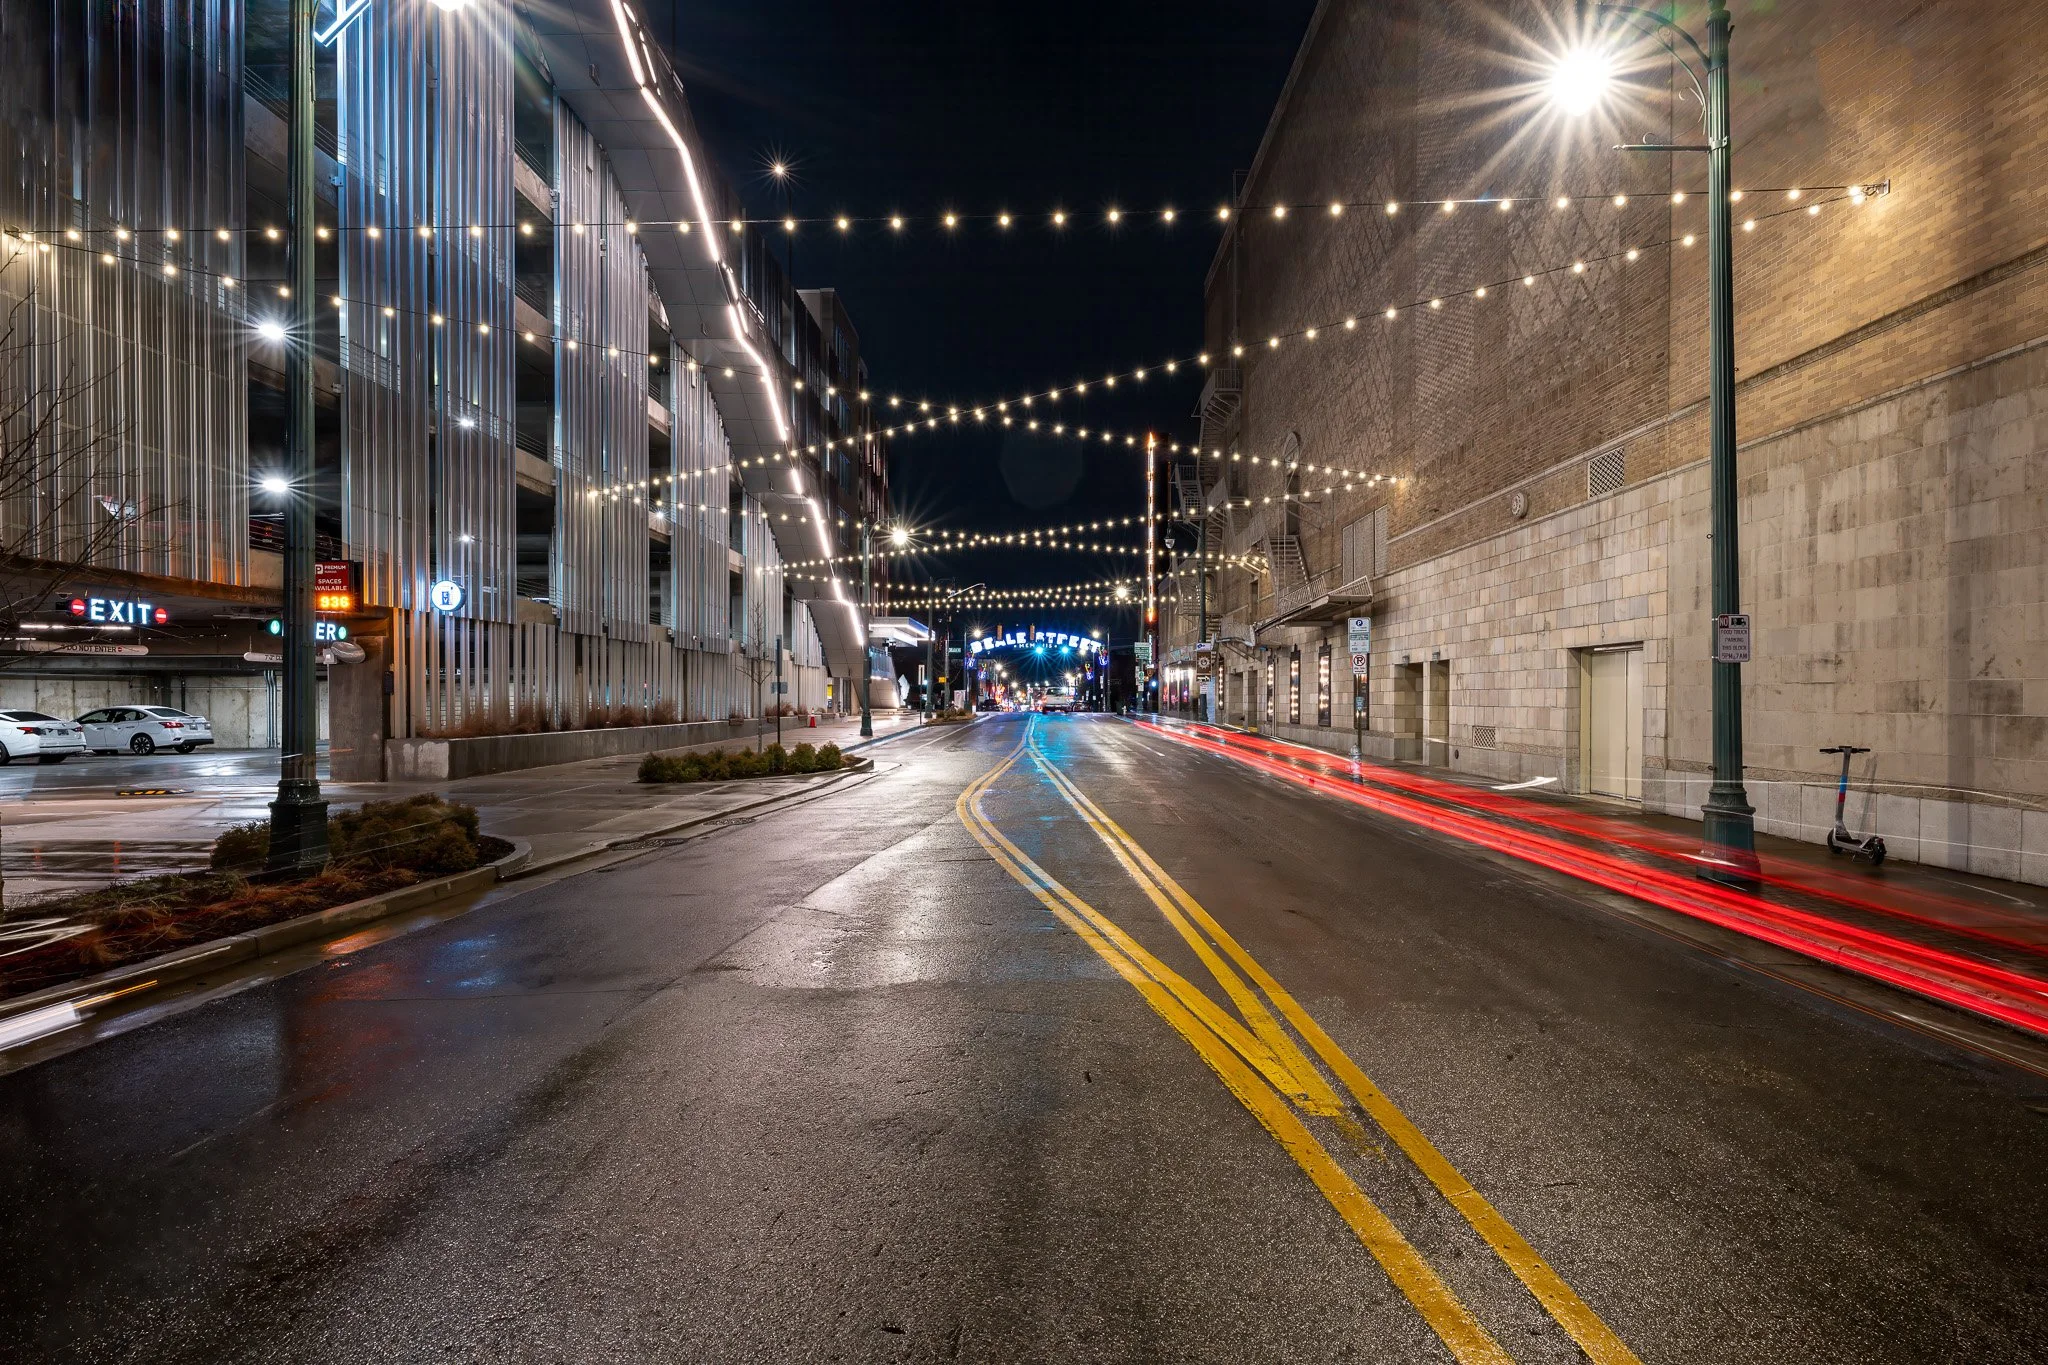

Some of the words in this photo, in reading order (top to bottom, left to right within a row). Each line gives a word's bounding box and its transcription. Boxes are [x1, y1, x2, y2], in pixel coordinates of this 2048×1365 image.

[321, 596, 349, 608] 936
[90, 598, 151, 624] EXIT
[1720, 616, 1729, 627] NO
